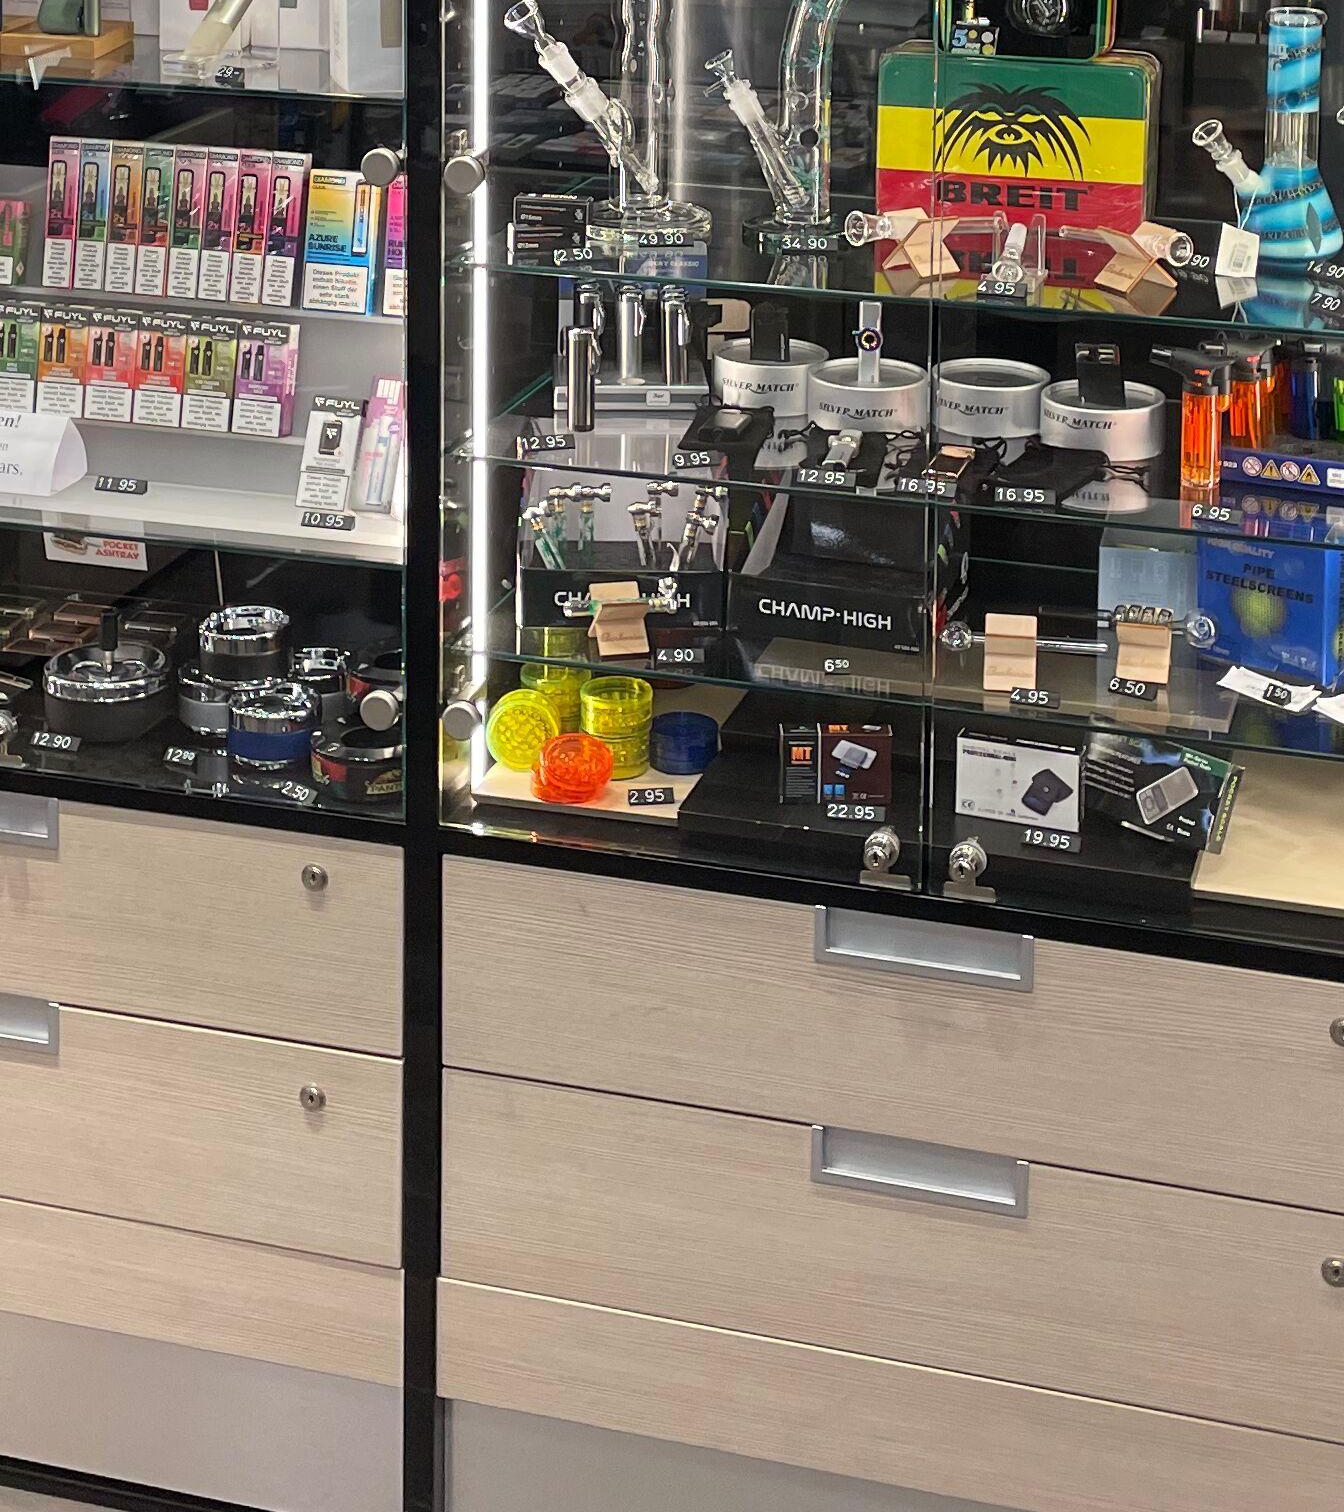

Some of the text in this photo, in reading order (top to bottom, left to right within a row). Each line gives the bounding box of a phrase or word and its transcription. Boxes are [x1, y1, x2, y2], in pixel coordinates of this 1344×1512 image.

[937, 180, 1089, 211] BREIT
[674, 452, 712, 468] 9.95
[997, 488, 1045, 504] 16.95
[1243, 563, 1276, 581] PIPE
[1206, 570, 1315, 605] STEELSCREENS
[657, 648, 695, 664] 4.90
[1109, 677, 1147, 696] 6.50
[1010, 688, 1050, 706] 4.95
[629, 789, 666, 804] 2.95
[827, 803, 875, 820] 22.95
[1023, 828, 1071, 850] 19.95
